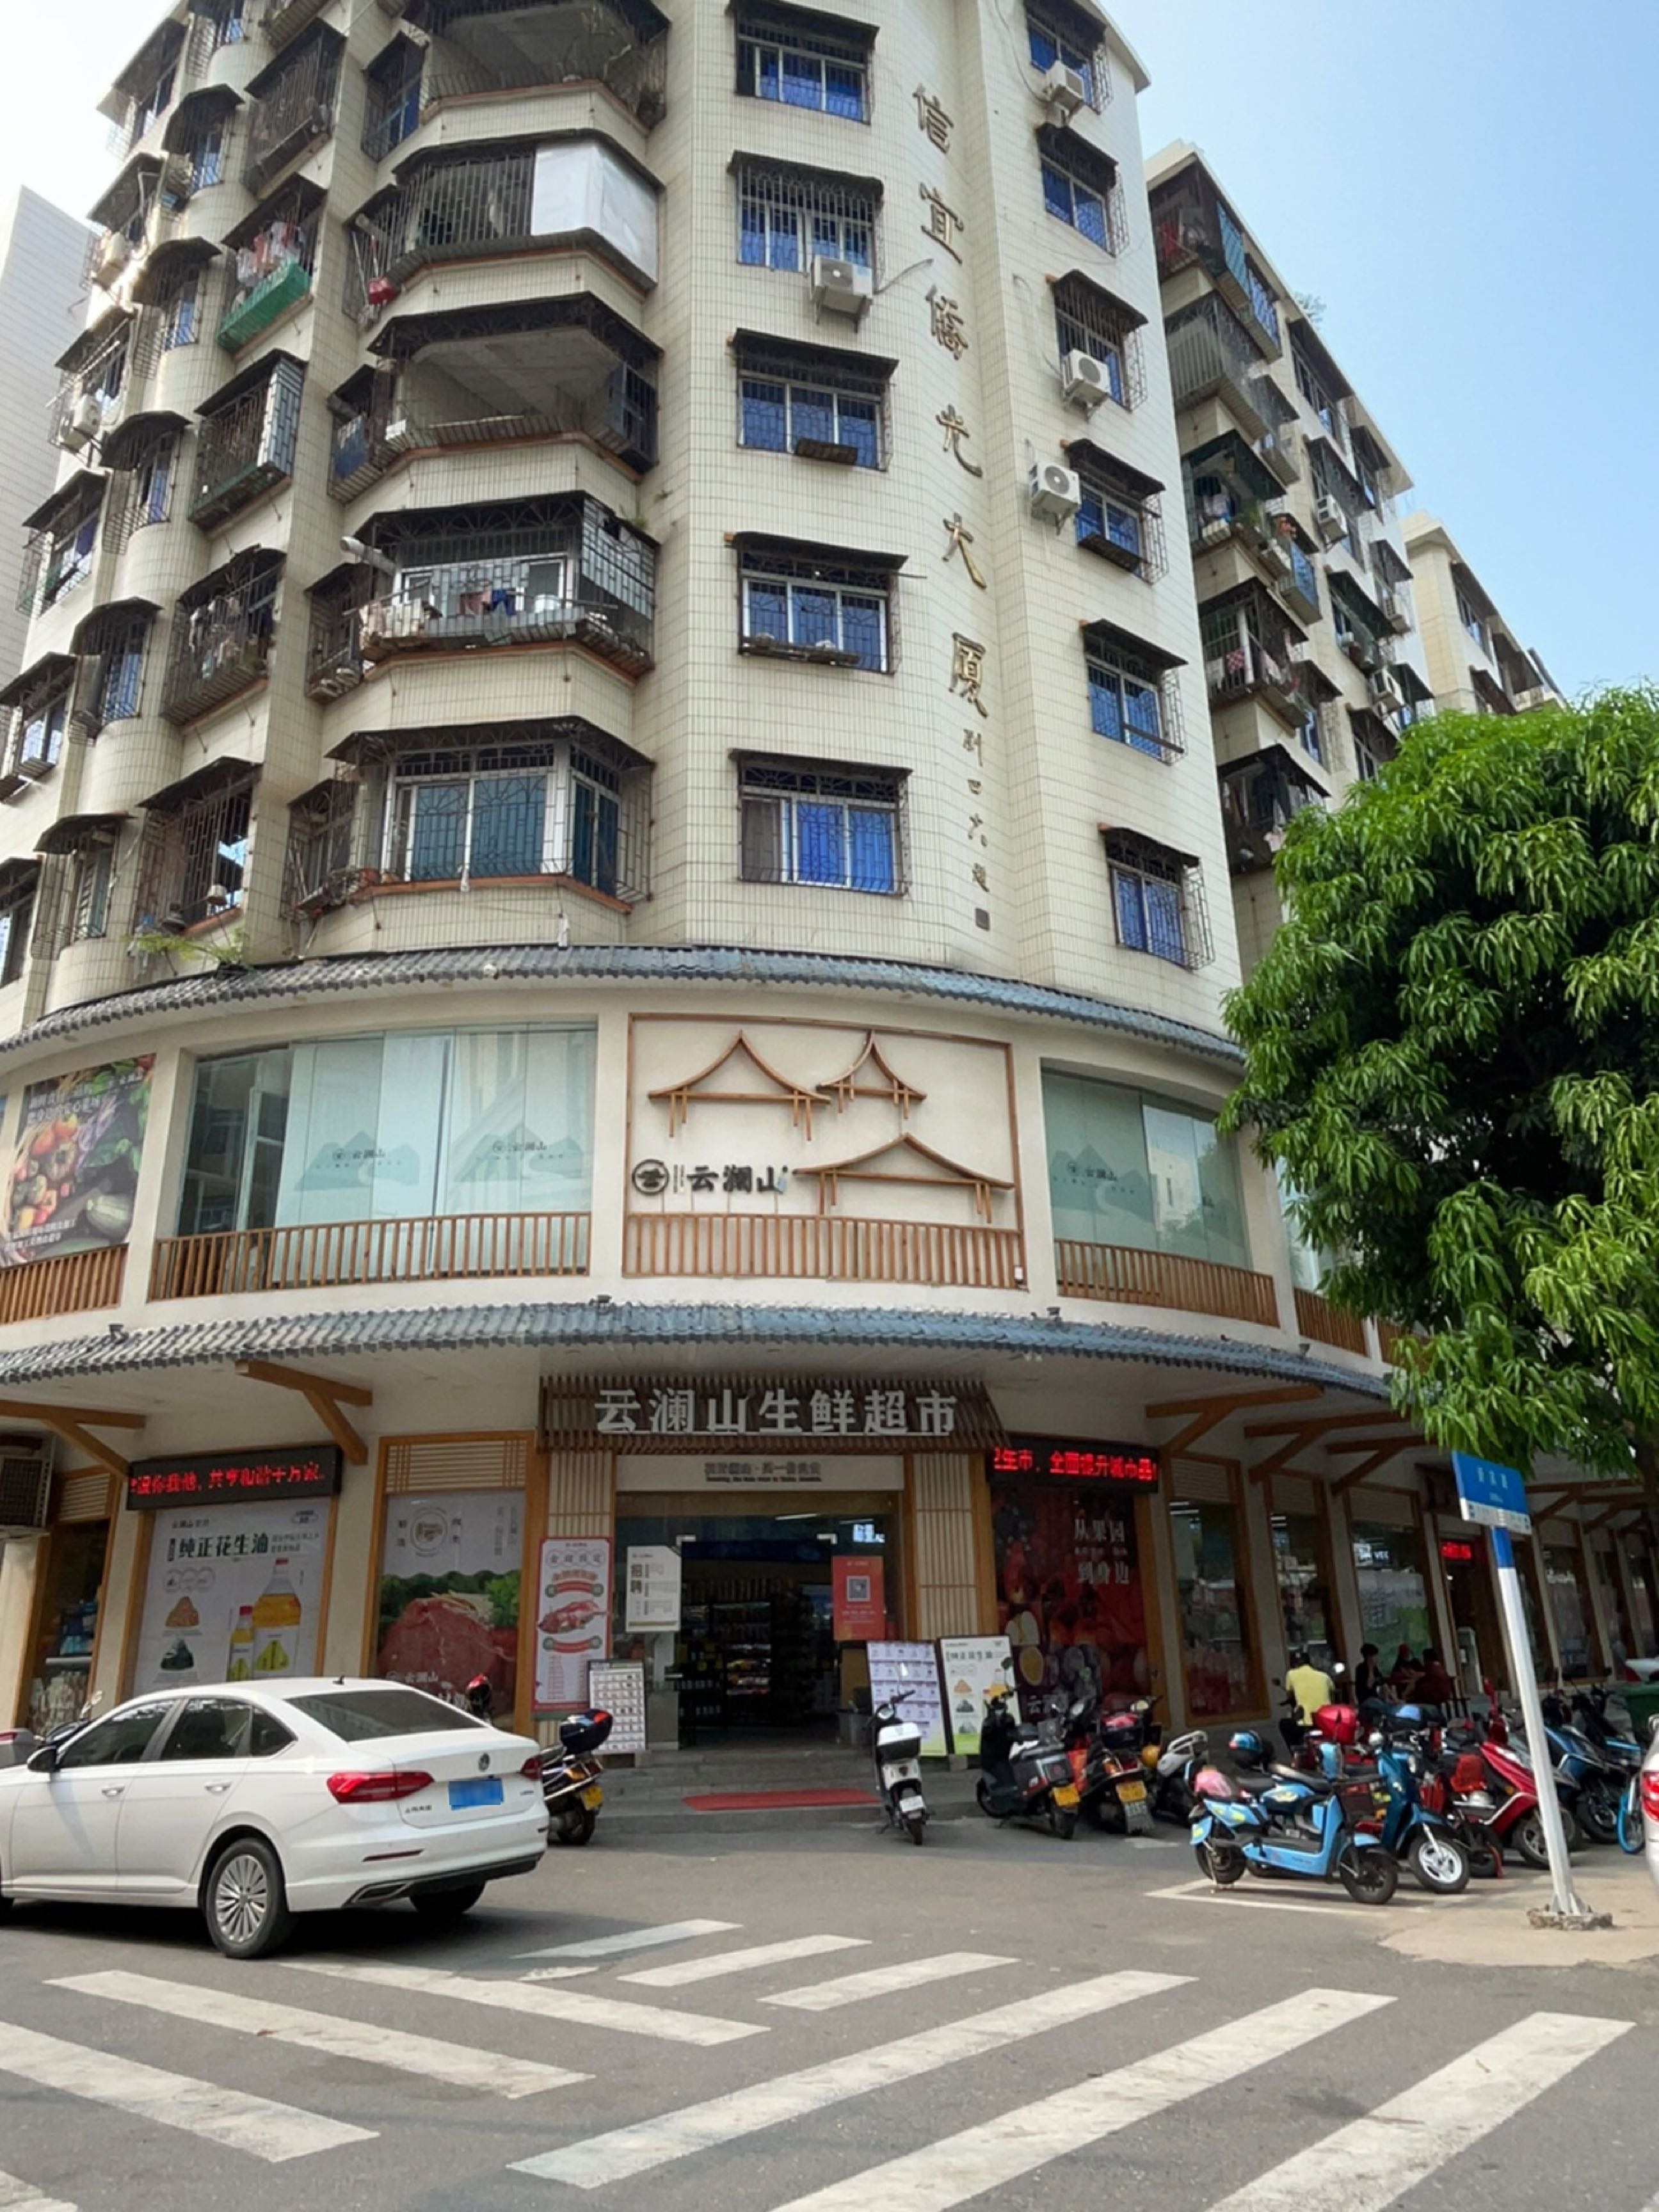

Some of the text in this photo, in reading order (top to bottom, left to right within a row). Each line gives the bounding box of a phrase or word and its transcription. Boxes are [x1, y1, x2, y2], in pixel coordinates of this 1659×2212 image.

[595, 1388, 958, 1435] 云澜山生鲜超市
[178, 1533, 269, 1559] 纯正花生油
[1077, 1562, 1130, 1584] 到身边
